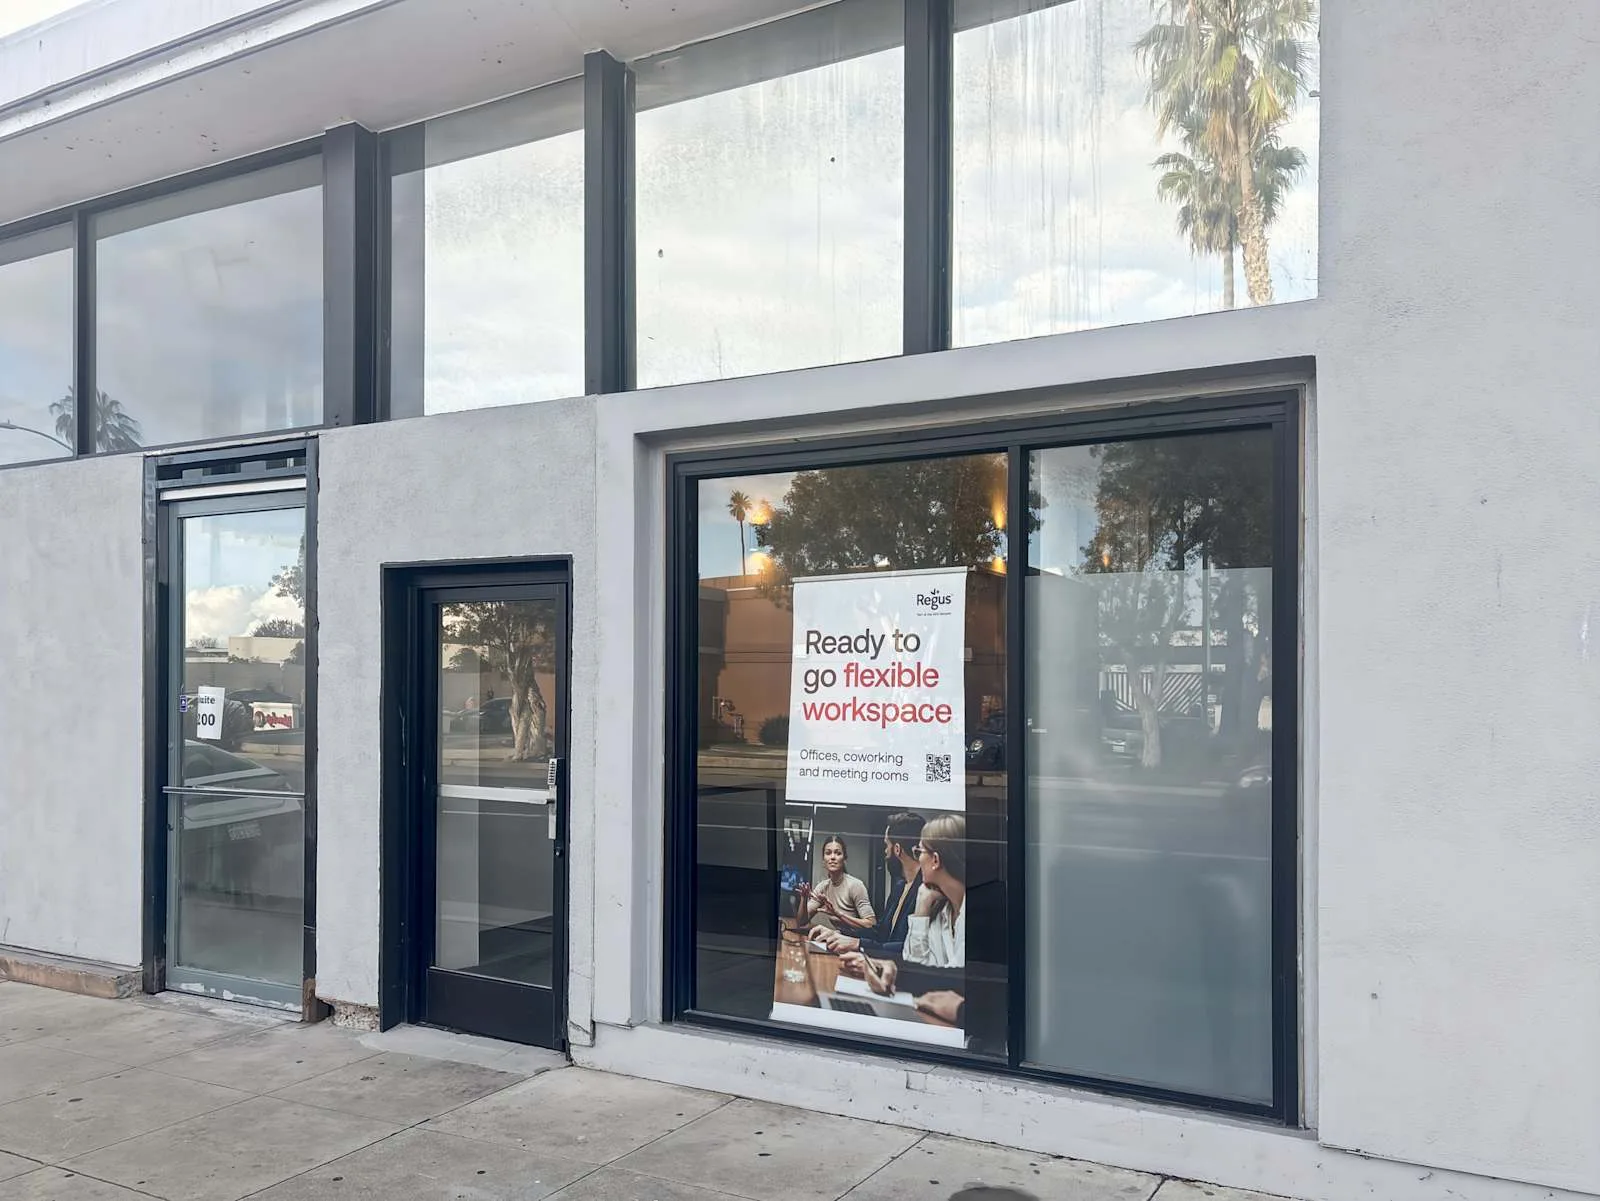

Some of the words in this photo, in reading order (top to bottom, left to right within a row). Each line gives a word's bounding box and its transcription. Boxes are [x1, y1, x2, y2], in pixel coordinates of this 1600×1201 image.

[916, 593, 952, 610] Regus
[805, 628, 885, 660] Ready
[892, 628, 921, 653] to
[804, 668, 837, 694] go
[843, 661, 939, 688] flexible
[198, 695, 216, 705] uite
[802, 696, 953, 729] workspace
[800, 748, 841, 763] Offices,
[843, 751, 904, 766] coworking
[799, 766, 820, 778] and
[822, 767, 868, 782] meeting
[871, 771, 909, 782] rooms
